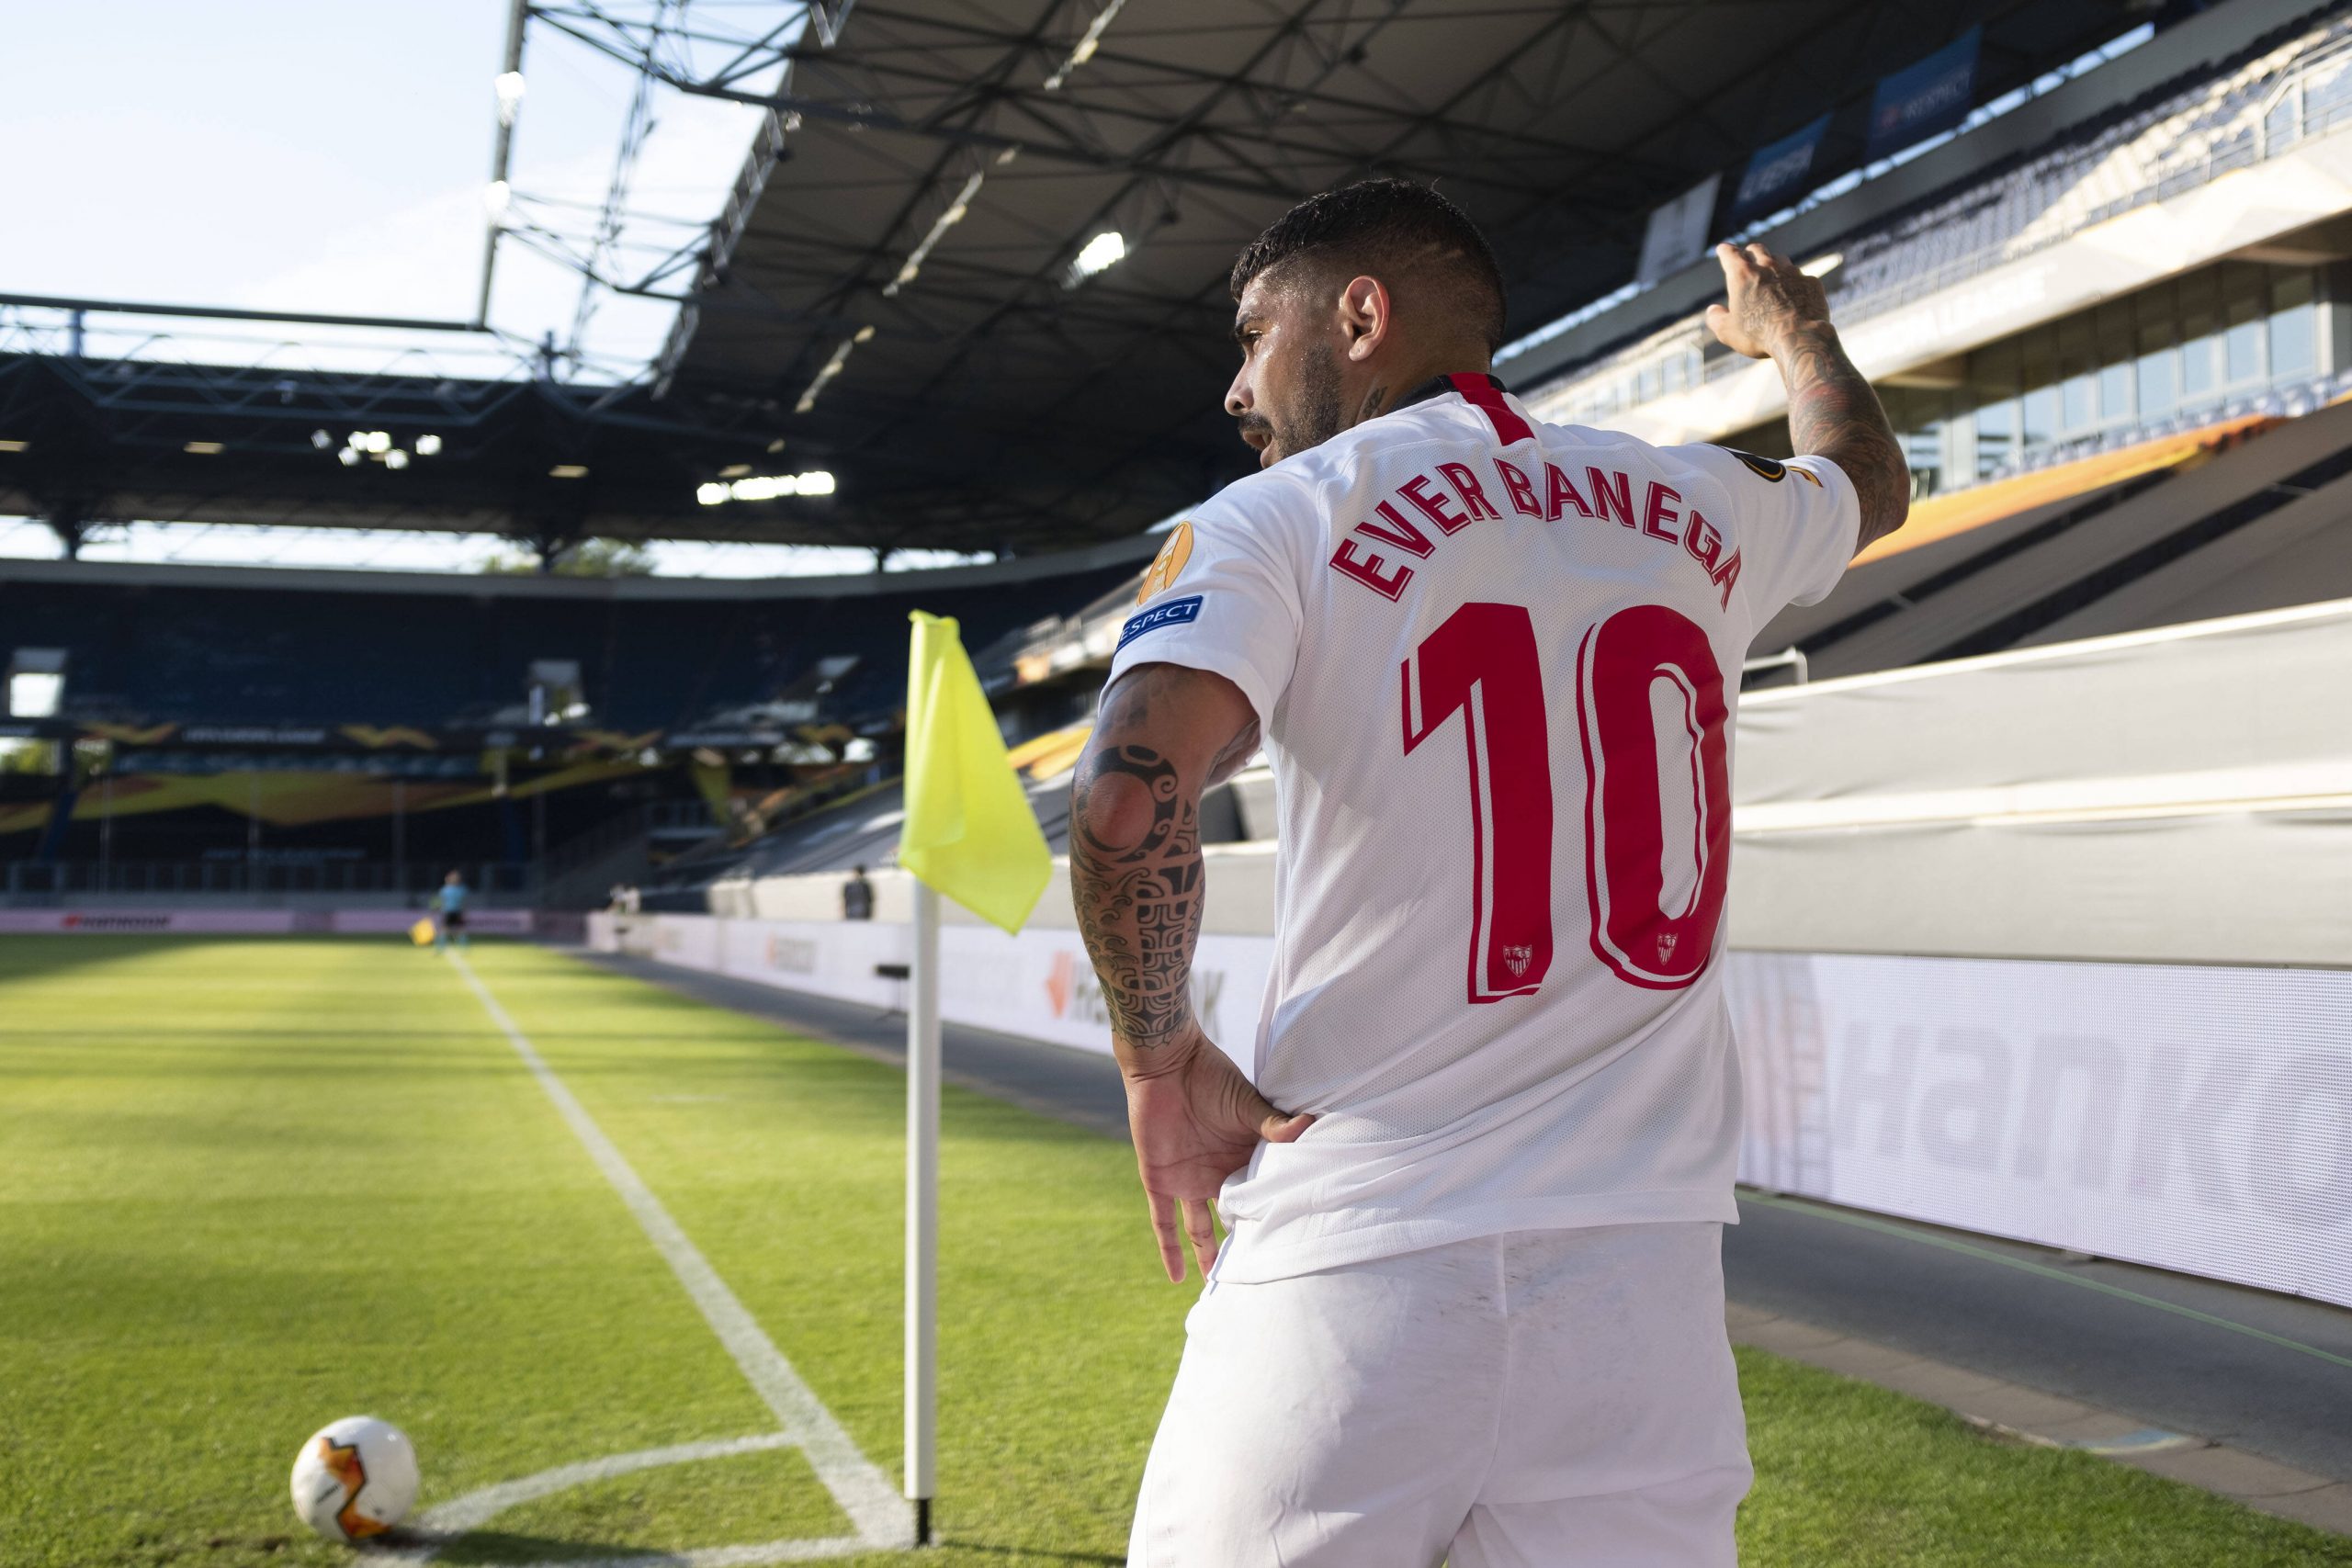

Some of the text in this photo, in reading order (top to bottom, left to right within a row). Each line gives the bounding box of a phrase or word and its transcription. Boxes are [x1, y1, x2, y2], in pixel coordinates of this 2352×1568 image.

[1331, 458, 1741, 613] EVER BANEGA
[1120, 604, 1199, 641] ESPECT
[1401, 603, 1730, 1004] 10
